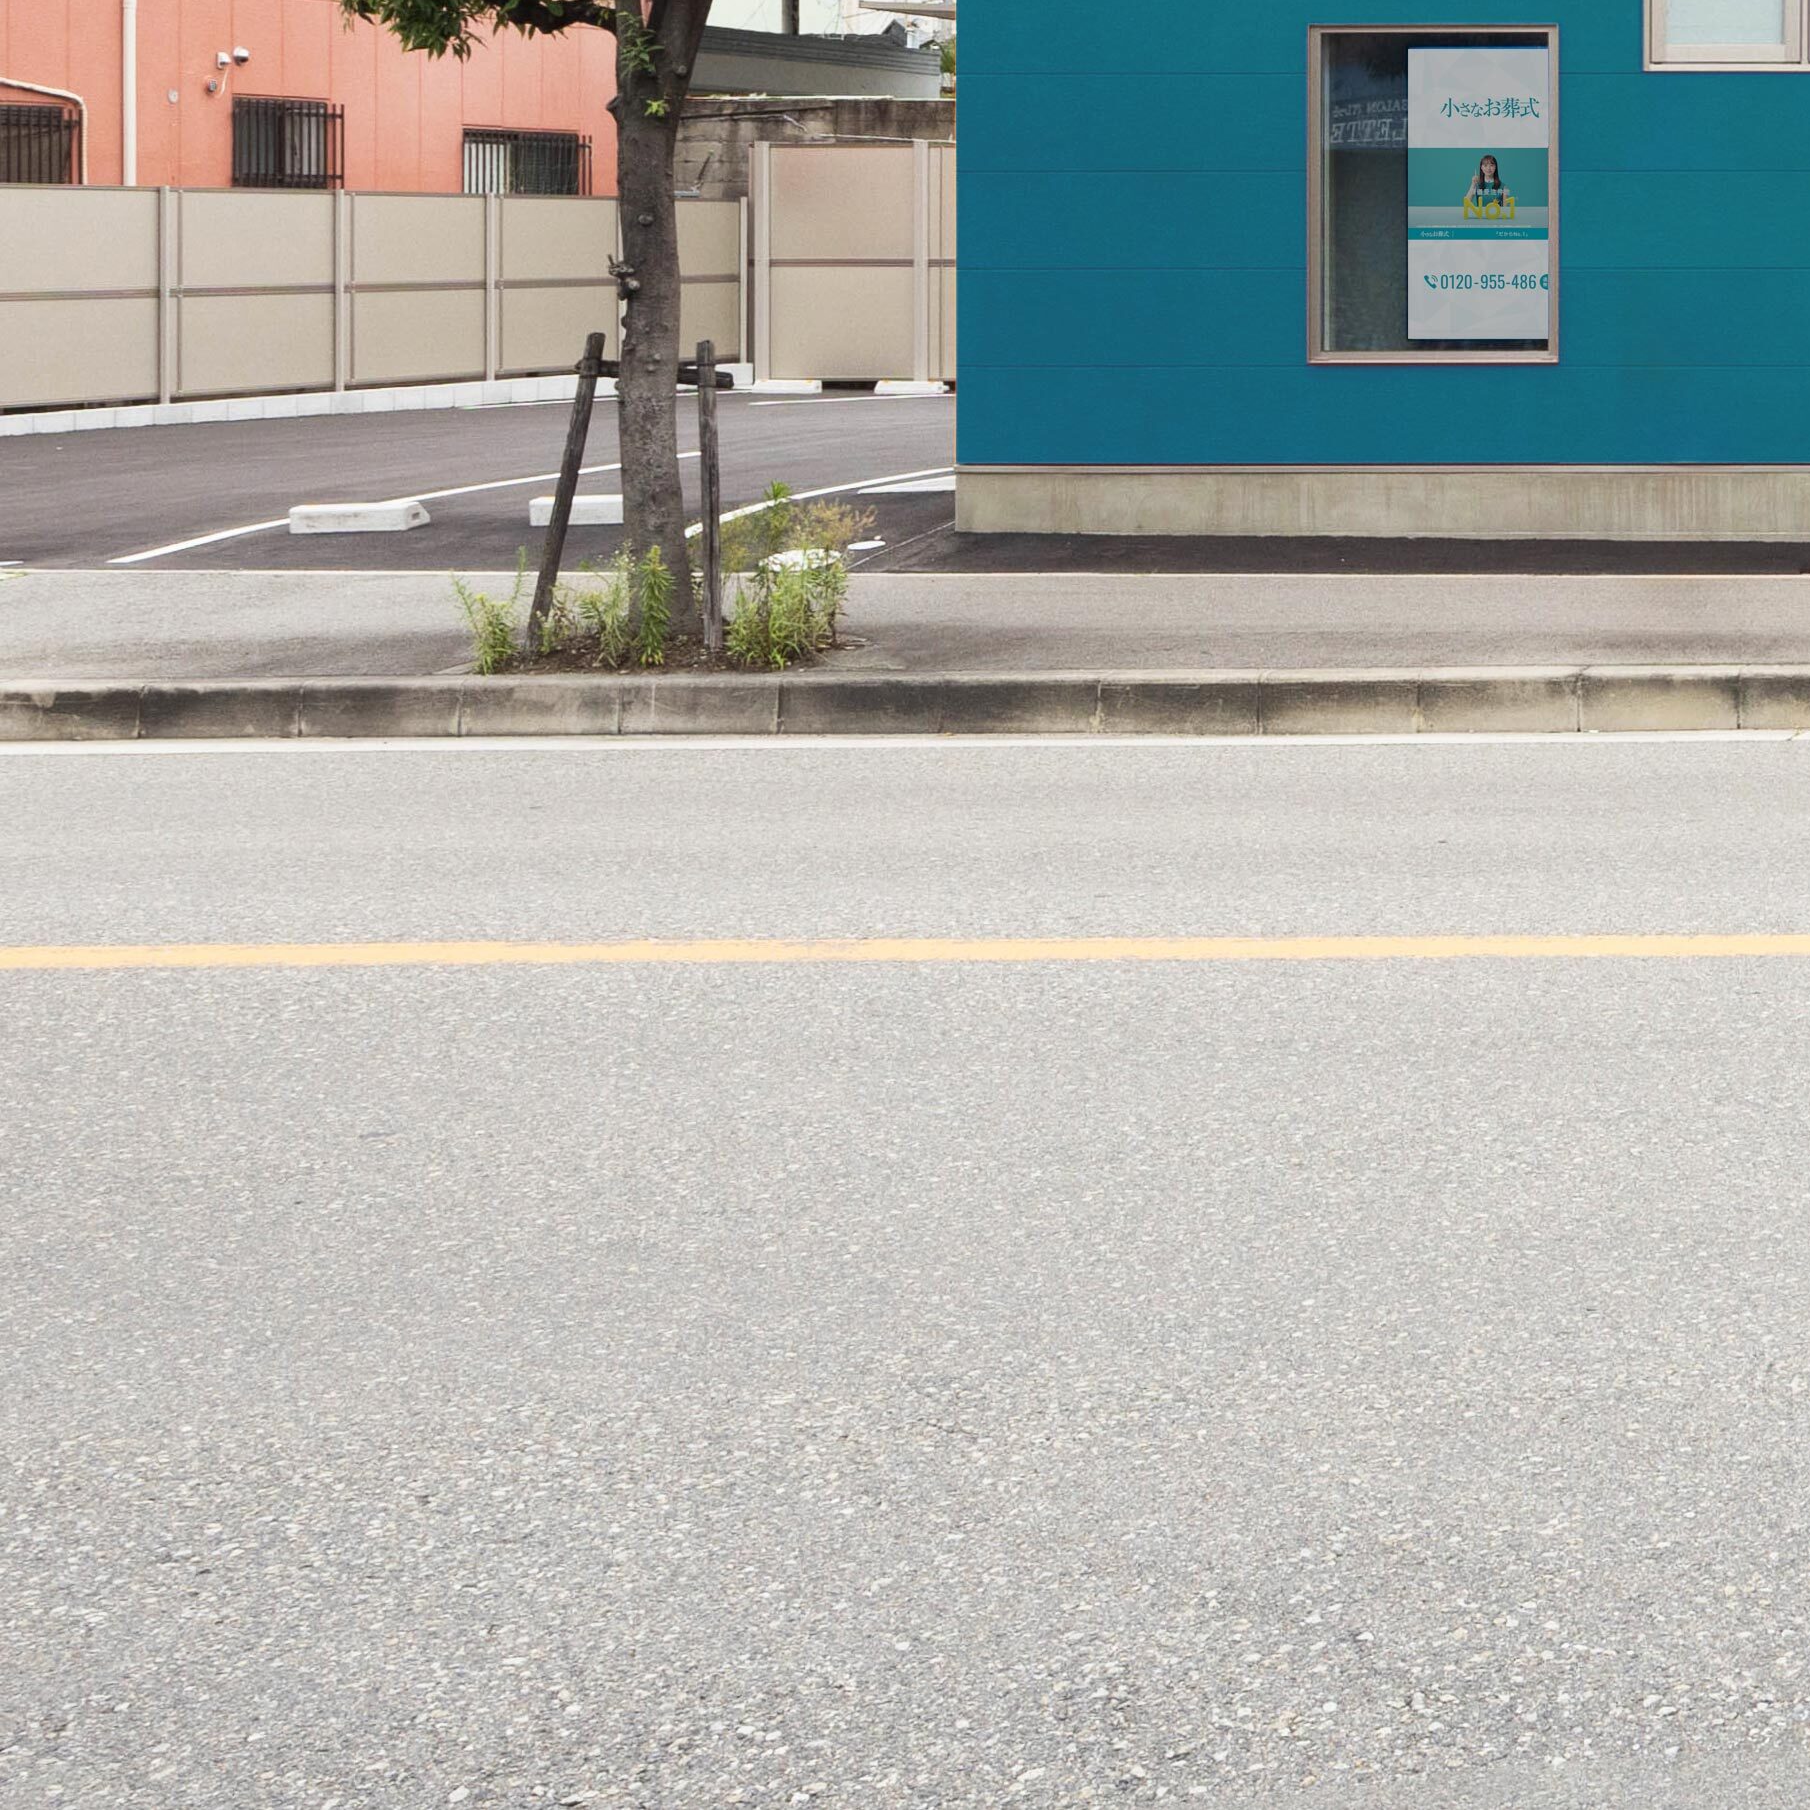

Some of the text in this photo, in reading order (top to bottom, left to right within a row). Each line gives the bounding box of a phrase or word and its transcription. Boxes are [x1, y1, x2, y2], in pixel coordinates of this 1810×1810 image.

[1440, 97, 1540, 119] 小さなお葬式
[1463, 195, 1516, 220] No.1
[1440, 273, 1537, 290] 0120-955-486
